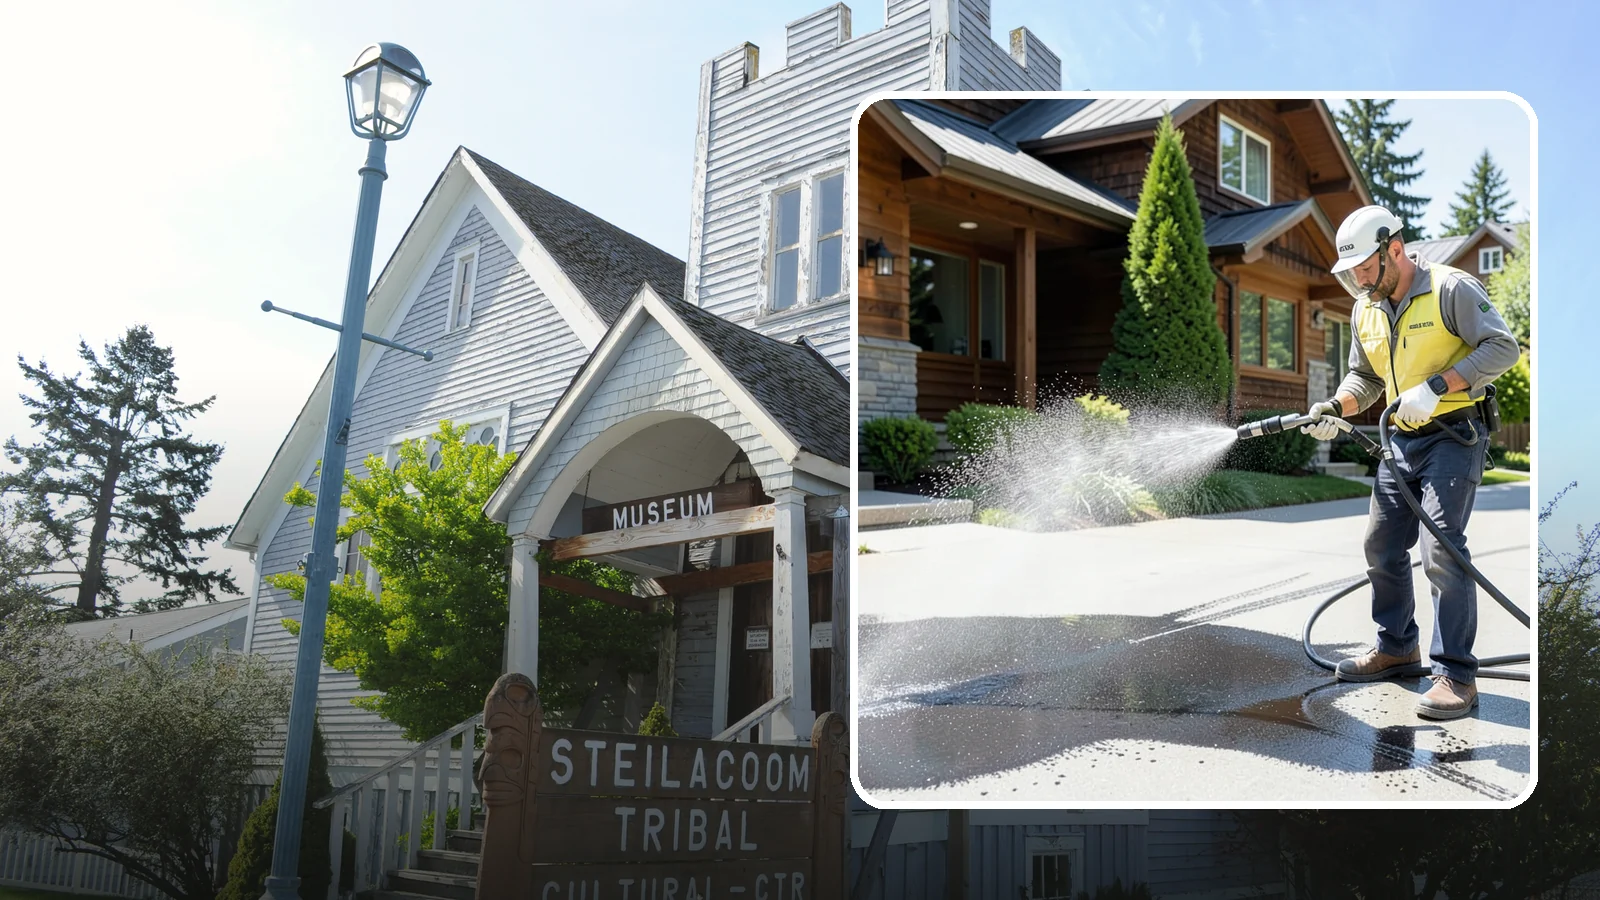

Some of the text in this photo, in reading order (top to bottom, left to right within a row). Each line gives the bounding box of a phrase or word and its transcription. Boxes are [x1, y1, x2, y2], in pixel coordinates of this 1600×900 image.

[612, 491, 714, 531] MUSEUM
[550, 737, 809, 793] STEILACOOM
[615, 806, 758, 852] TRIBAL
